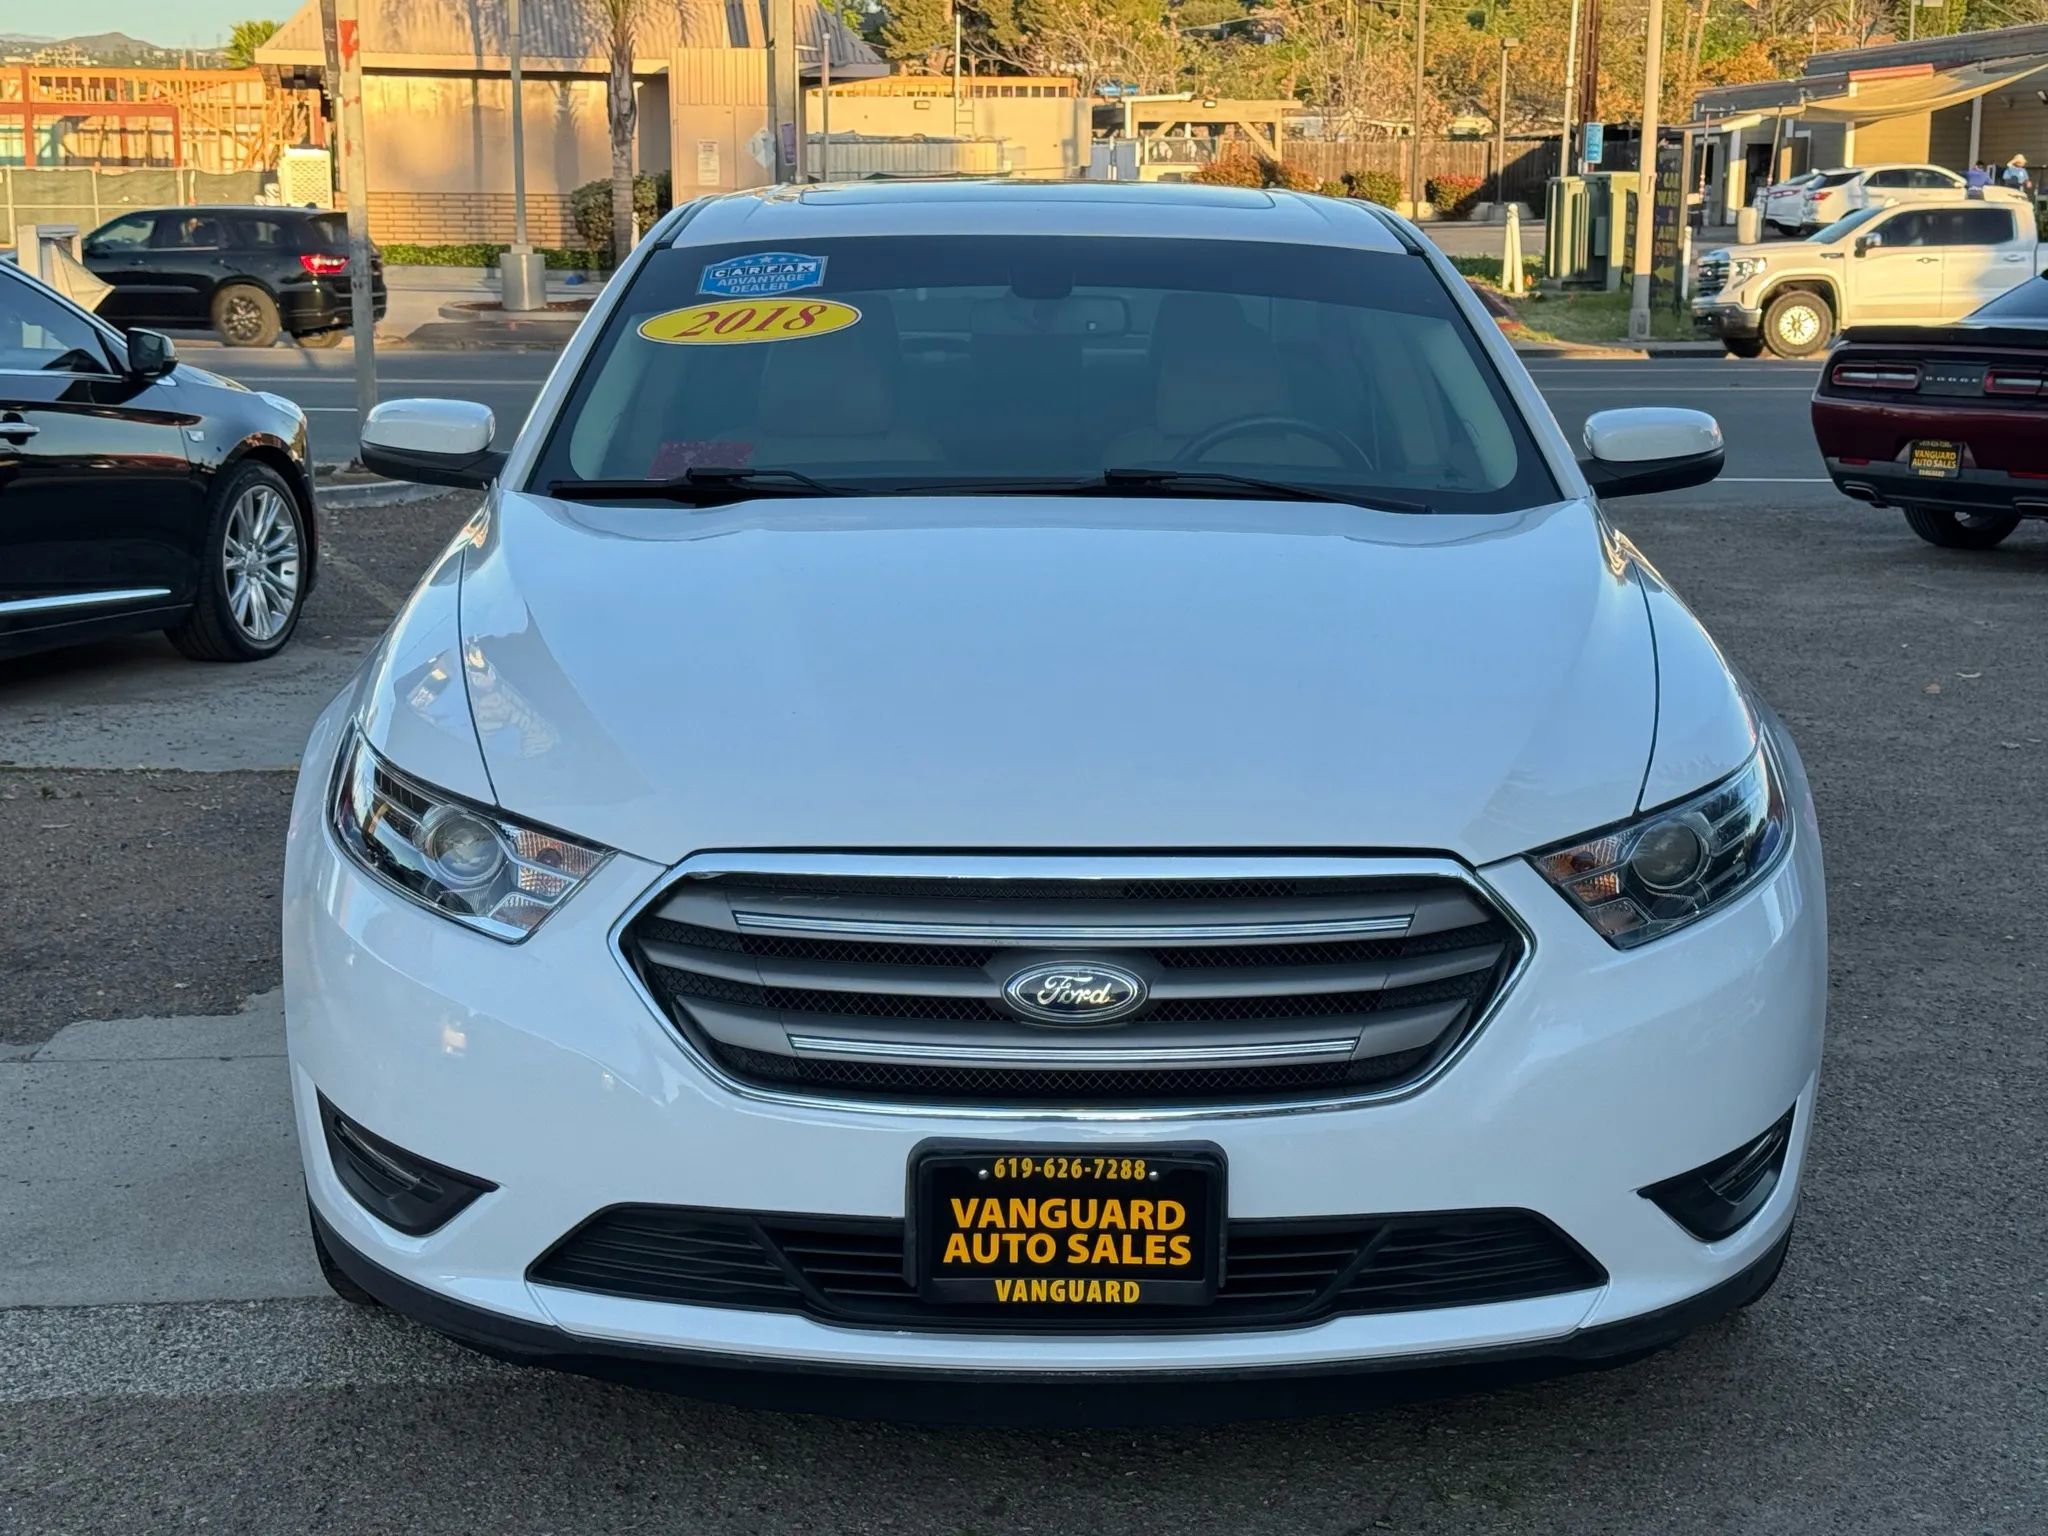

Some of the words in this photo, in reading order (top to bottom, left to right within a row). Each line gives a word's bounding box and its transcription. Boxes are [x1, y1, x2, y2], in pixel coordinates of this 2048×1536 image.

[713, 262, 816, 279] CARFAX
[717, 272, 806, 287] ADVANTAGE
[730, 281, 789, 294] DEALER
[673, 304, 828, 338] 2018
[1912, 458, 1933, 467] AUTO
[1933, 459, 1957, 469] SALES
[1914, 449, 1957, 460] VANGUARD
[1037, 975, 1114, 1005] Ford
[994, 1157, 1146, 1180] 619-626-7288
[950, 1198, 1186, 1230] VANGUARD
[943, 1233, 1057, 1264] AUTO
[1067, 1234, 1192, 1266] SALES
[995, 1279, 1141, 1303] VANGUARD
